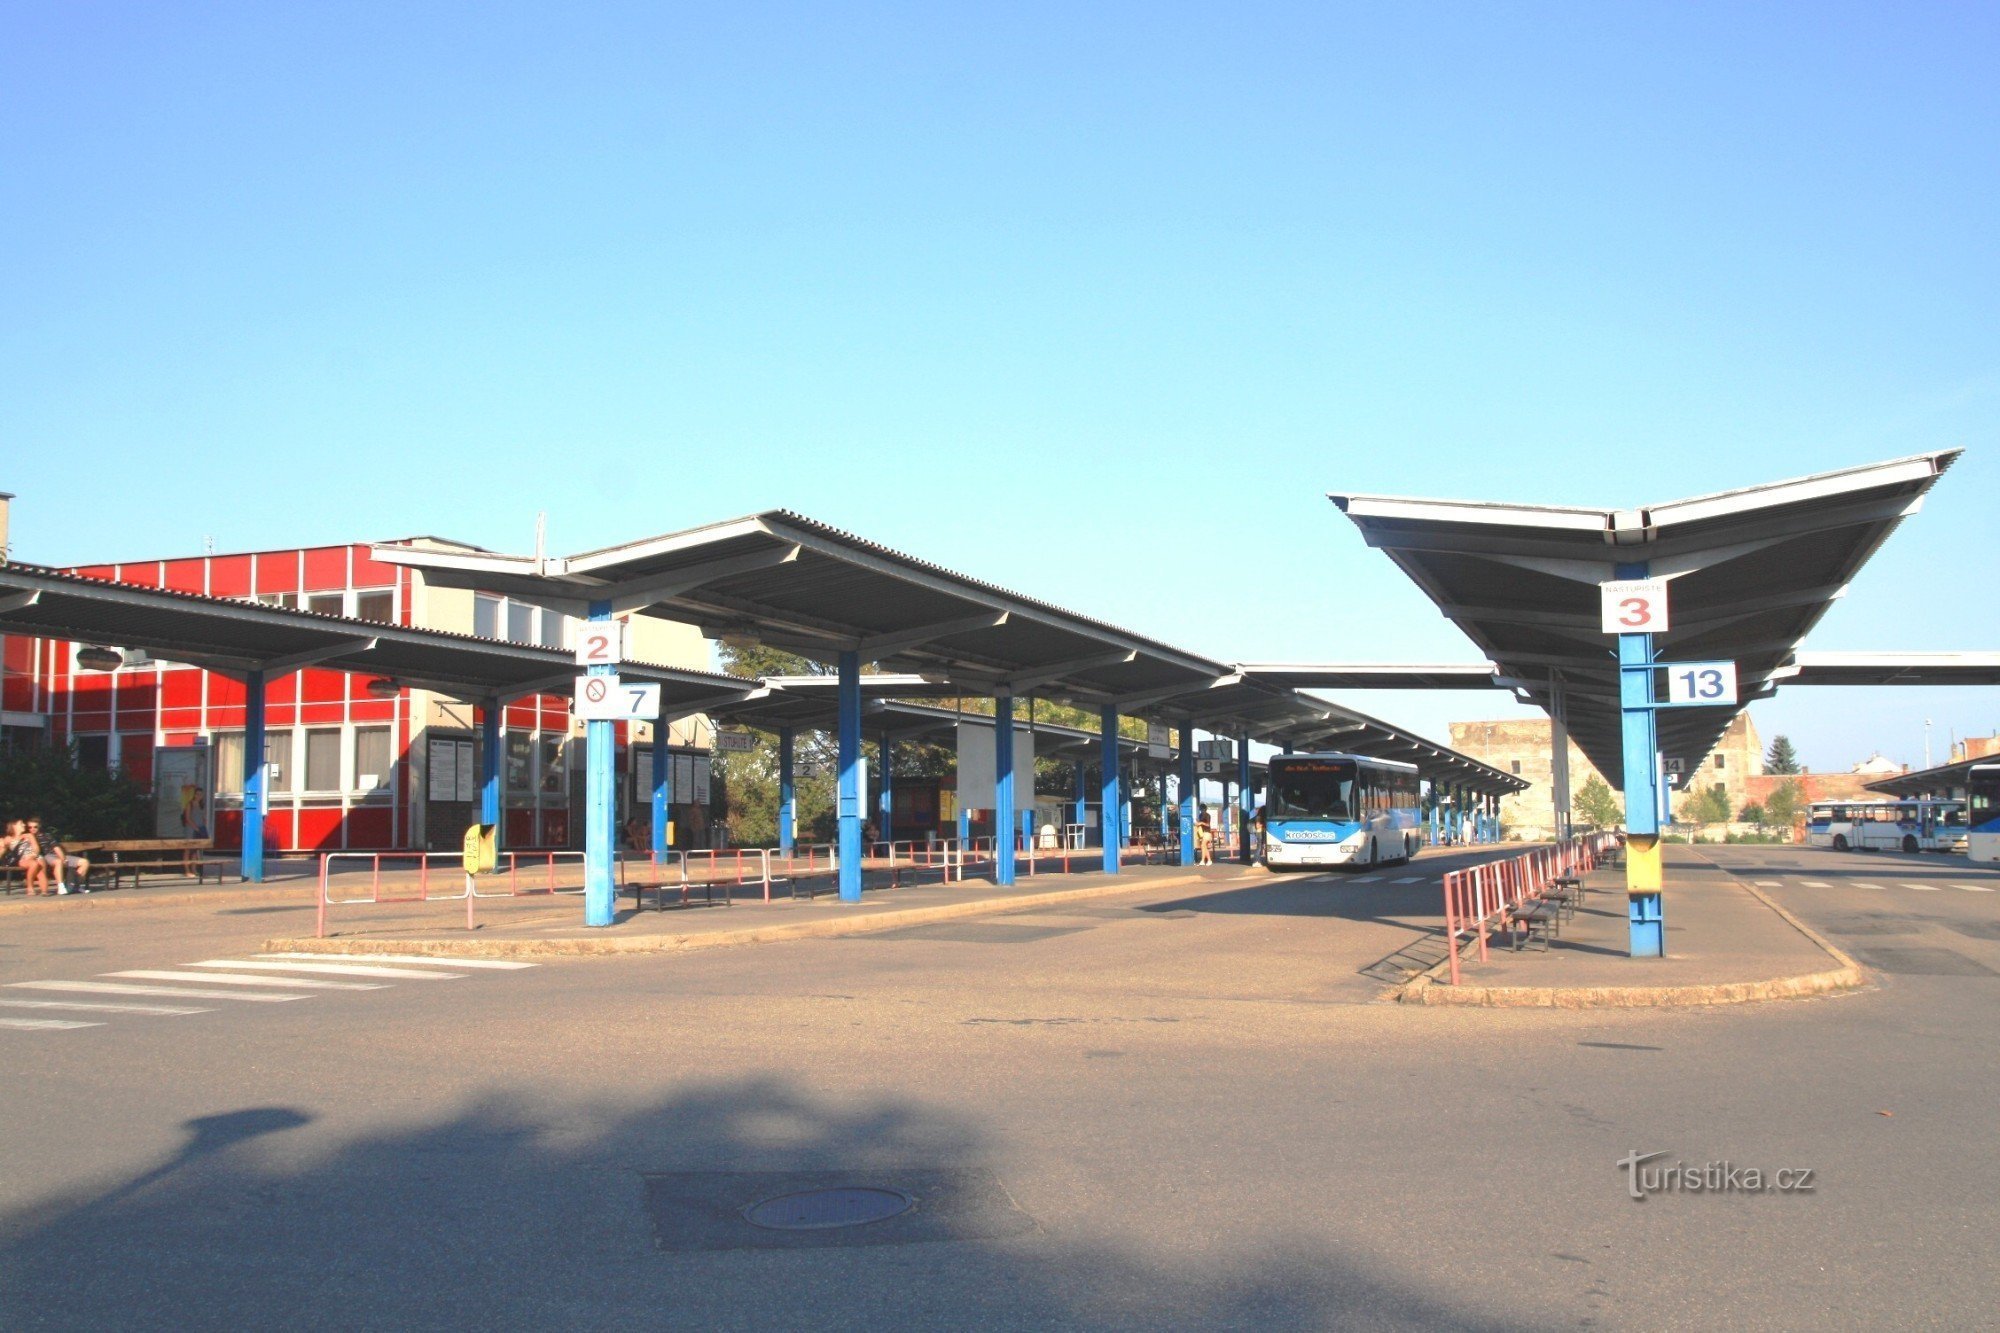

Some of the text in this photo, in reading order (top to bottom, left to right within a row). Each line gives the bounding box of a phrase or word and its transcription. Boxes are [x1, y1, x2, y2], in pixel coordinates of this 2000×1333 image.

[1619, 597, 1651, 626] 3
[587, 636, 608, 659] 2
[1680, 669, 1724, 698] 13
[629, 690, 647, 713] 7
[802, 765, 811, 775] 2
[1204, 761, 1213, 772] 8
[1663, 760, 1679, 772] 14
